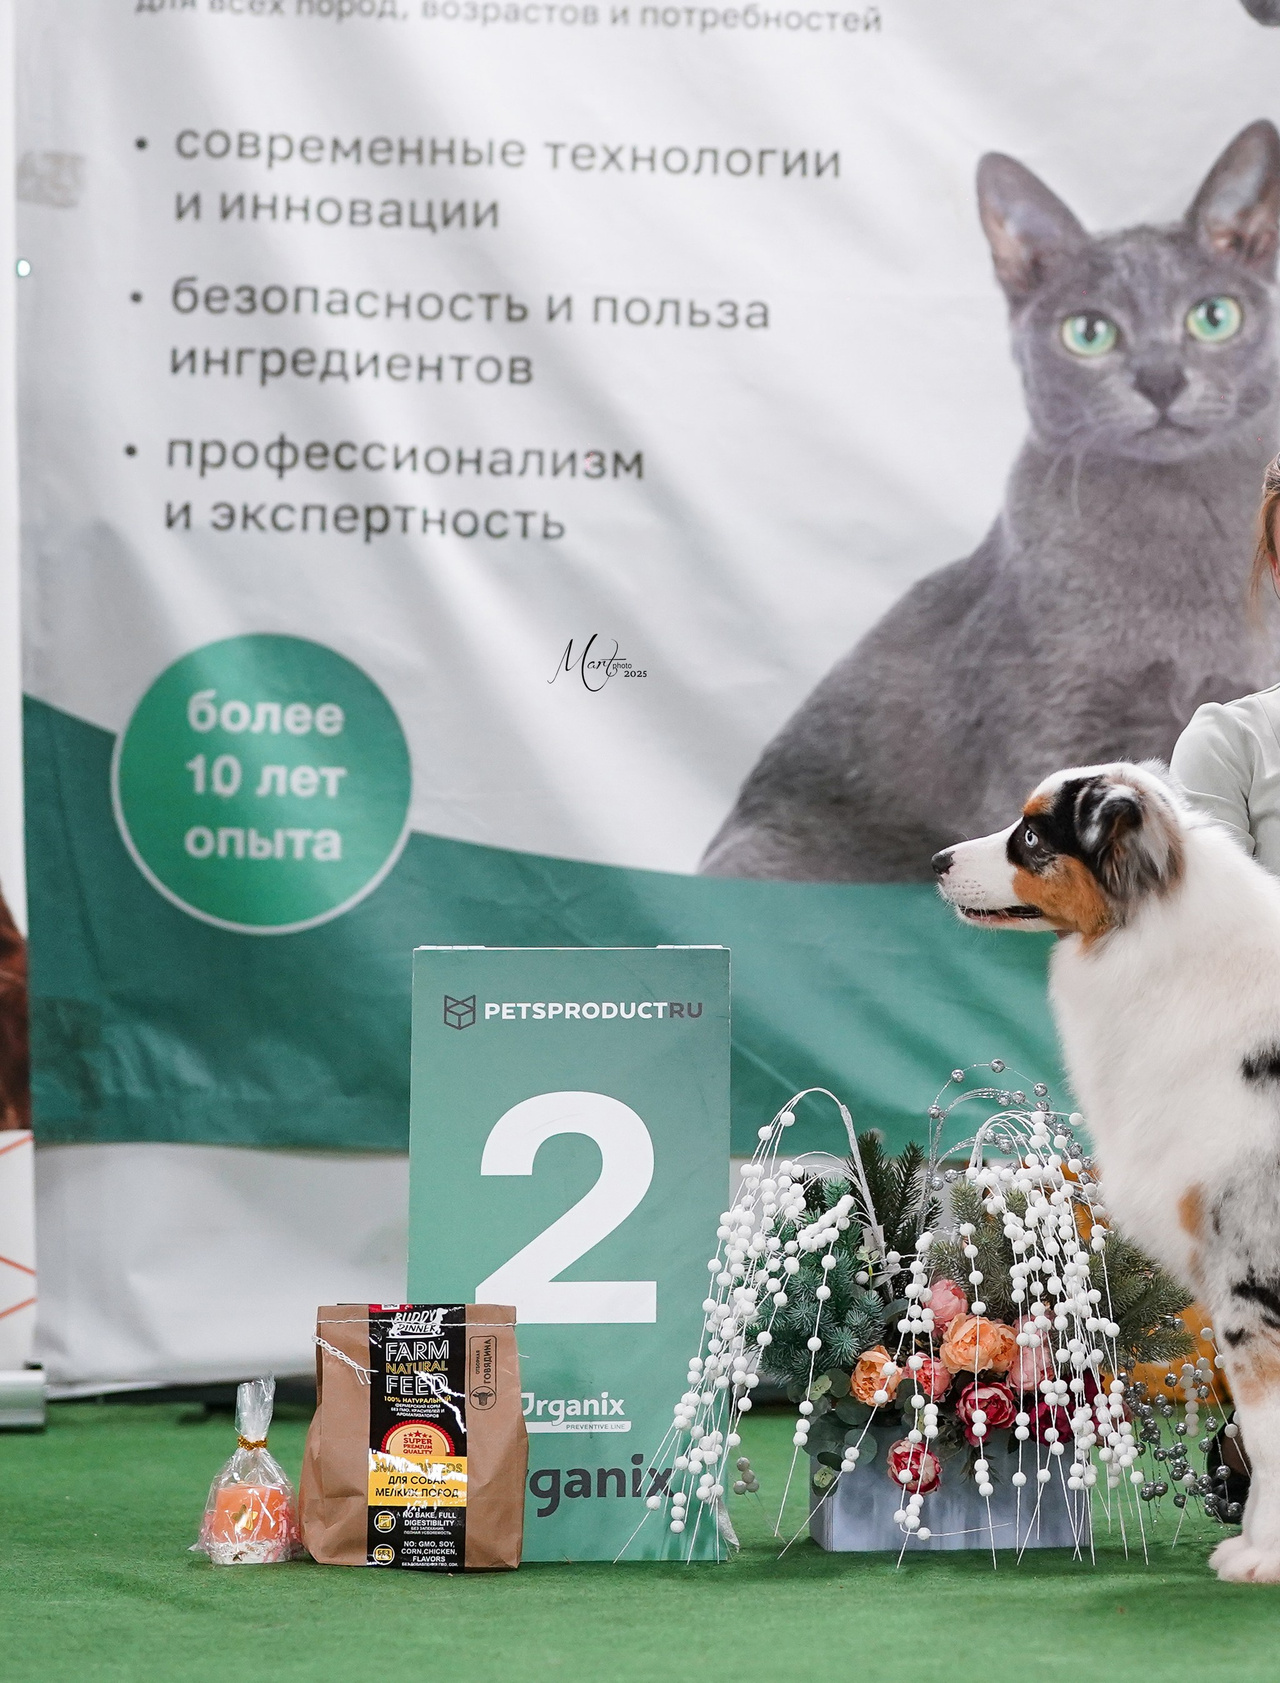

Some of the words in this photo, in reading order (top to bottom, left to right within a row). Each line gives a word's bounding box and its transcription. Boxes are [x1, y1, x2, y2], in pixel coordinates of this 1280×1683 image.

[422, 1, 599, 27] возрастов
[610, 7, 631, 26] и
[640, 3, 883, 33] потребностей
[174, 128, 527, 170] современные
[543, 141, 841, 179] технологии
[174, 191, 202, 222] и
[219, 192, 499, 235] инновации
[170, 275, 530, 324] безопасность
[546, 294, 574, 324] и
[592, 295, 770, 330] польза
[169, 346, 533, 389] ингредиентов
[166, 432, 645, 480] профессионализм
[164, 501, 193, 531] и
[210, 501, 566, 545] экспертность
[187, 688, 345, 737] более
[185, 753, 243, 798] 10
[256, 764, 348, 797] лет
[184, 825, 342, 861] опыта
[475, 1090, 657, 1323] 2
[394, 1309, 437, 1323] BUDDY
[385, 1339, 450, 1362] FARM
[483, 1338, 493, 1385] ГОВЯДИНА
[385, 1360, 449, 1375] NATURAL
[383, 1395, 401, 1403] 100%
[385, 1373, 450, 1396] FEED
[403, 1437, 433, 1445] SUPER
[375, 1487, 419, 1498] МЕЛКИХ
[421, 1488, 459, 1499] ПОРОД
[388, 1475, 408, 1485] ДЛЯ
[526, 1453, 675, 1518] ganix
[402, 1511, 414, 1519] NO
[414, 1511, 437, 1519] BAKE,
[438, 1511, 457, 1519] FULL
[404, 1519, 455, 1527] DIGESTIBILITY
[403, 1540, 417, 1548] NO:
[418, 1540, 438, 1548] GMO,
[438, 1540, 456, 1549] SOY,
[412, 1555, 446, 1563] FLAVORS
